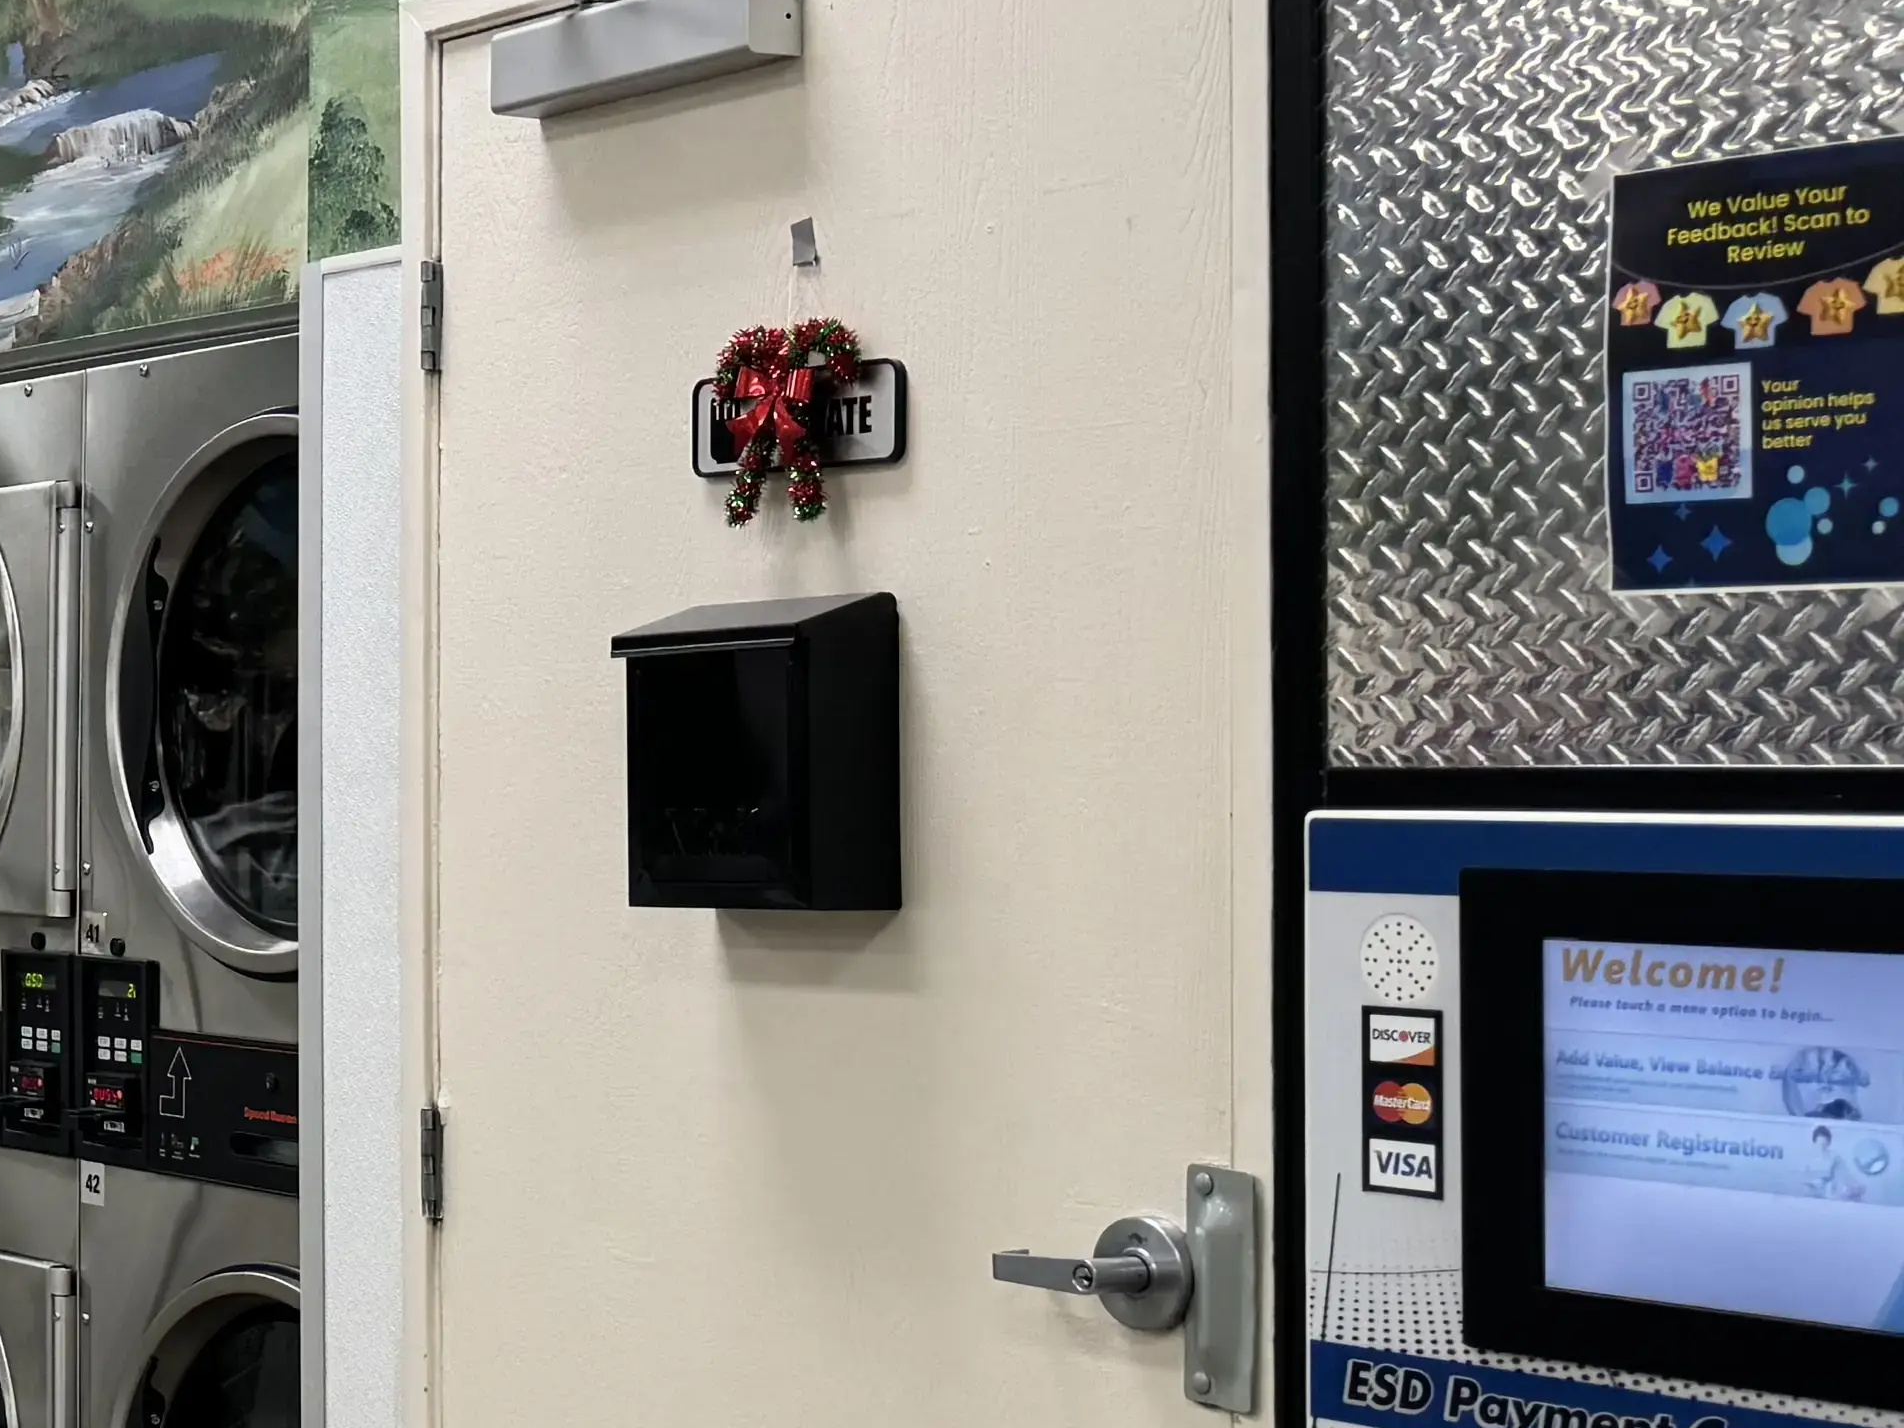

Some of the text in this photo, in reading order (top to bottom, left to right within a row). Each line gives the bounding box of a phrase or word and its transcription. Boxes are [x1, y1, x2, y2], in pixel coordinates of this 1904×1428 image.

[1687, 185, 1849, 219] We Value Your
[1667, 207, 1871, 246] Feedback! Scan to
[1727, 240, 1806, 264] Review
[1761, 380, 1801, 393] Your
[1761, 392, 1877, 416] opinion helps
[1762, 412, 1868, 431] us serve you
[1762, 434, 1814, 450] better
[86, 923, 100, 943] 41
[1562, 947, 1785, 994] Welcome!
[1569, 996, 1611, 1010] Please
[1616, 1000, 1653, 1012] touch
[1656, 1004, 1666, 1013] a
[1669, 1004, 1707, 1015] menu
[1712, 1005, 1757, 1019] option
[1761, 1008, 1776, 1019] to
[1372, 1028, 1432, 1045] DISCOVER
[1556, 1049, 1590, 1067] Add
[1595, 1052, 1644, 1073] Value,
[1648, 1056, 1691, 1074] View
[1696, 1059, 1763, 1079] Balance
[1373, 1094, 1431, 1112] MasterCard
[1556, 1120, 1650, 1148] Customer
[1657, 1129, 1784, 1160] Registration
[1374, 1149, 1433, 1180] VISA
[85, 1173, 101, 1194] 42
[1343, 1358, 1435, 1415] ESD
